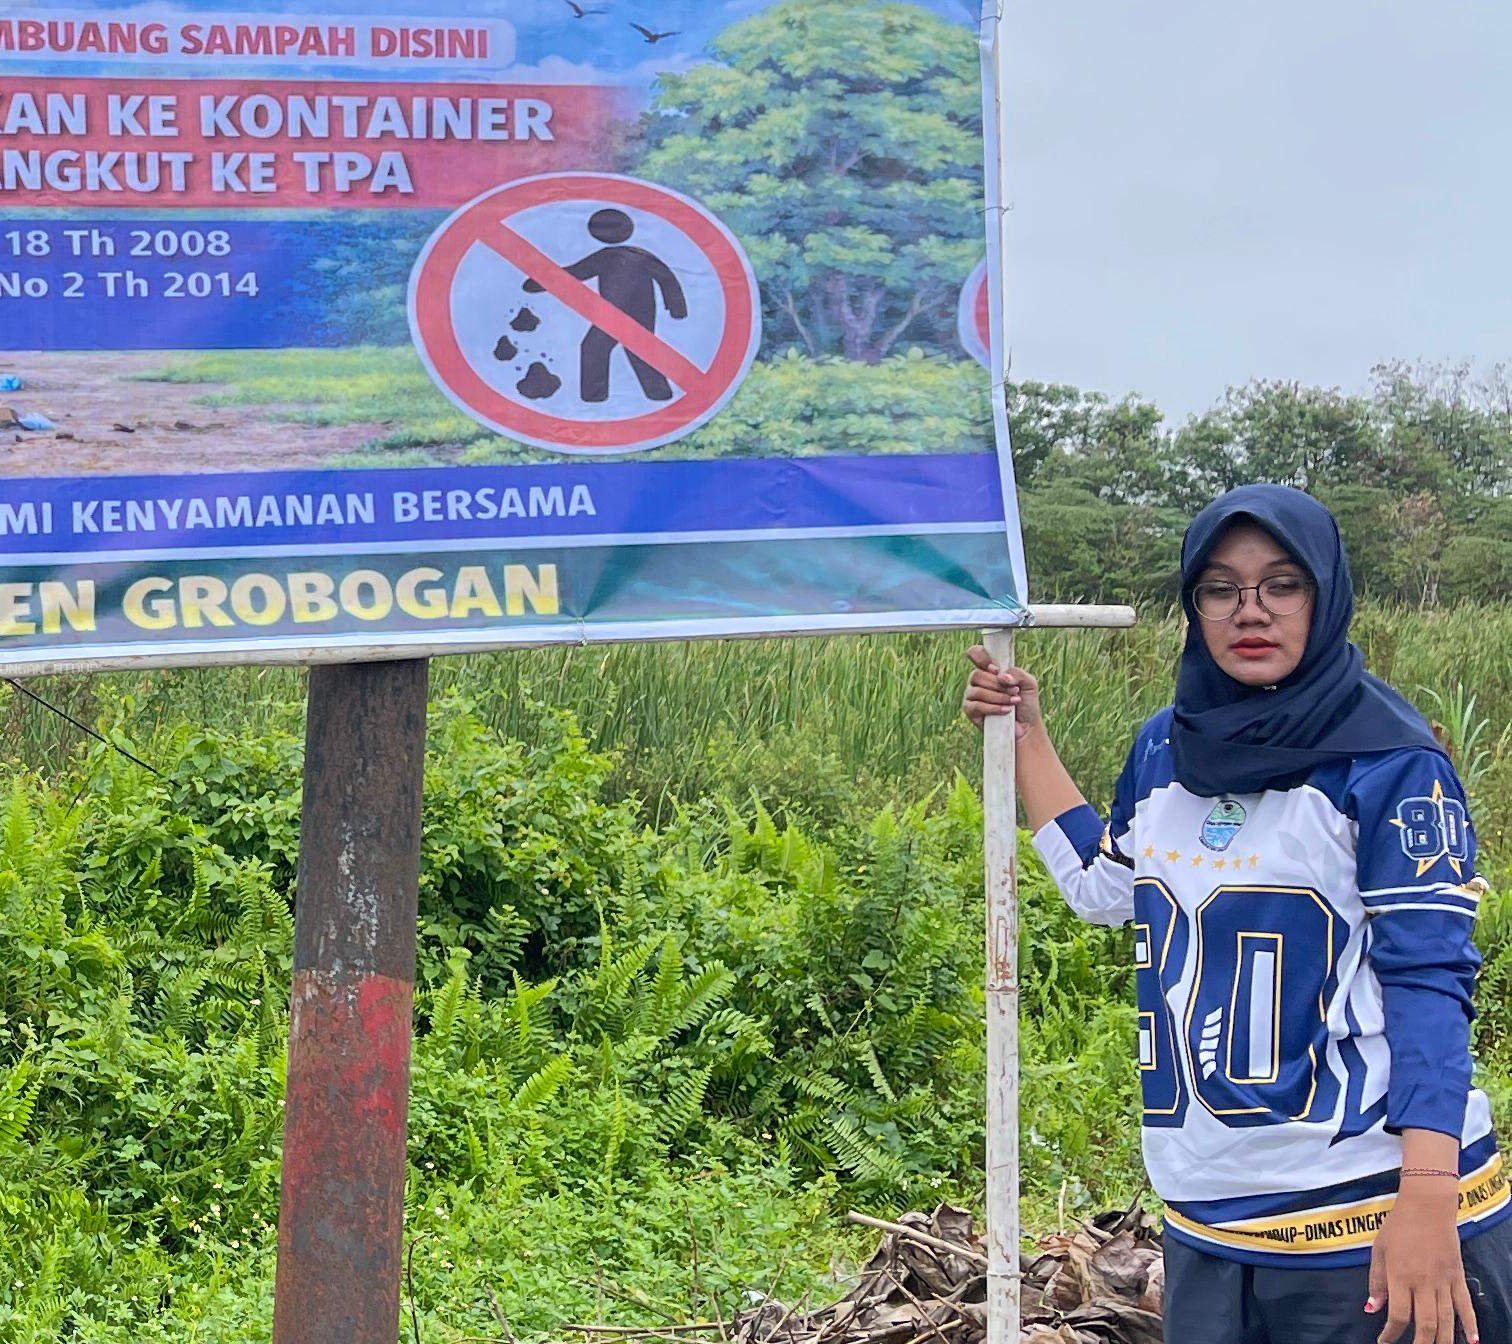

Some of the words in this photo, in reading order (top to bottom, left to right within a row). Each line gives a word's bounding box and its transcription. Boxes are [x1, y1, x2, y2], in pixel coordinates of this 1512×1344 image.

[180, 22, 356, 57] SAMPAH
[370, 27, 488, 59] DISINI
[107, 94, 179, 137] KE
[200, 94, 555, 141] KONTAINER
[211, 152, 277, 193] KE
[293, 152, 415, 194] TPA
[4, 229, 50, 256] 18
[63, 228, 116, 256] Th
[129, 229, 232, 256] 2008
[62, 271, 85, 297] 2
[97, 269, 150, 298] Th
[162, 270, 260, 298] 2014
[72, 492, 375, 534] KENYAMANAN
[394, 484, 596, 523] BERSAMA
[122, 563, 561, 630] GROBOGAN
[1397, 796, 1468, 862] 80
